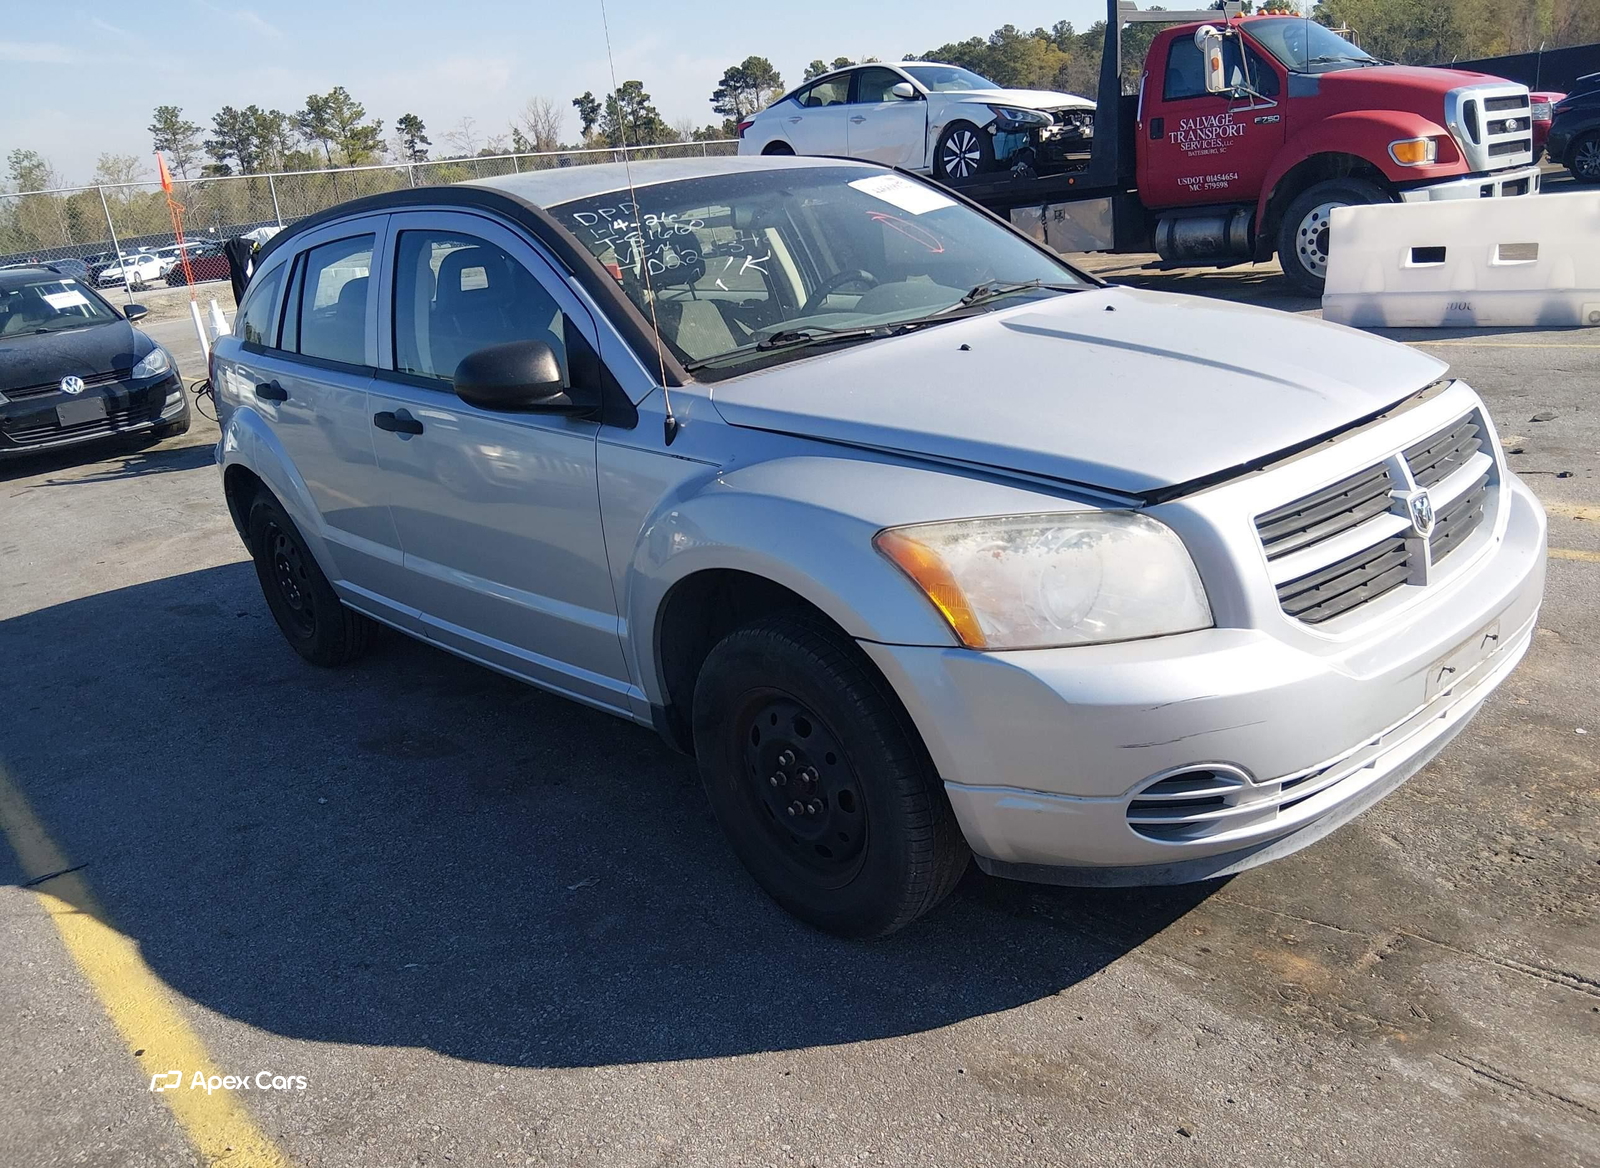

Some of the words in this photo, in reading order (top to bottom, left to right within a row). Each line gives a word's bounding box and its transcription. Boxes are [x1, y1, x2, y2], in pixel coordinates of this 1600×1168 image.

[1179, 113, 1234, 131] SALVAGE
[1169, 123, 1246, 144] TRANSPORT
[1177, 176, 1204, 186] USDOT
[1189, 183, 1202, 192] MC
[1204, 181, 1229, 191] 579598
[572, 202, 640, 226] DPD
